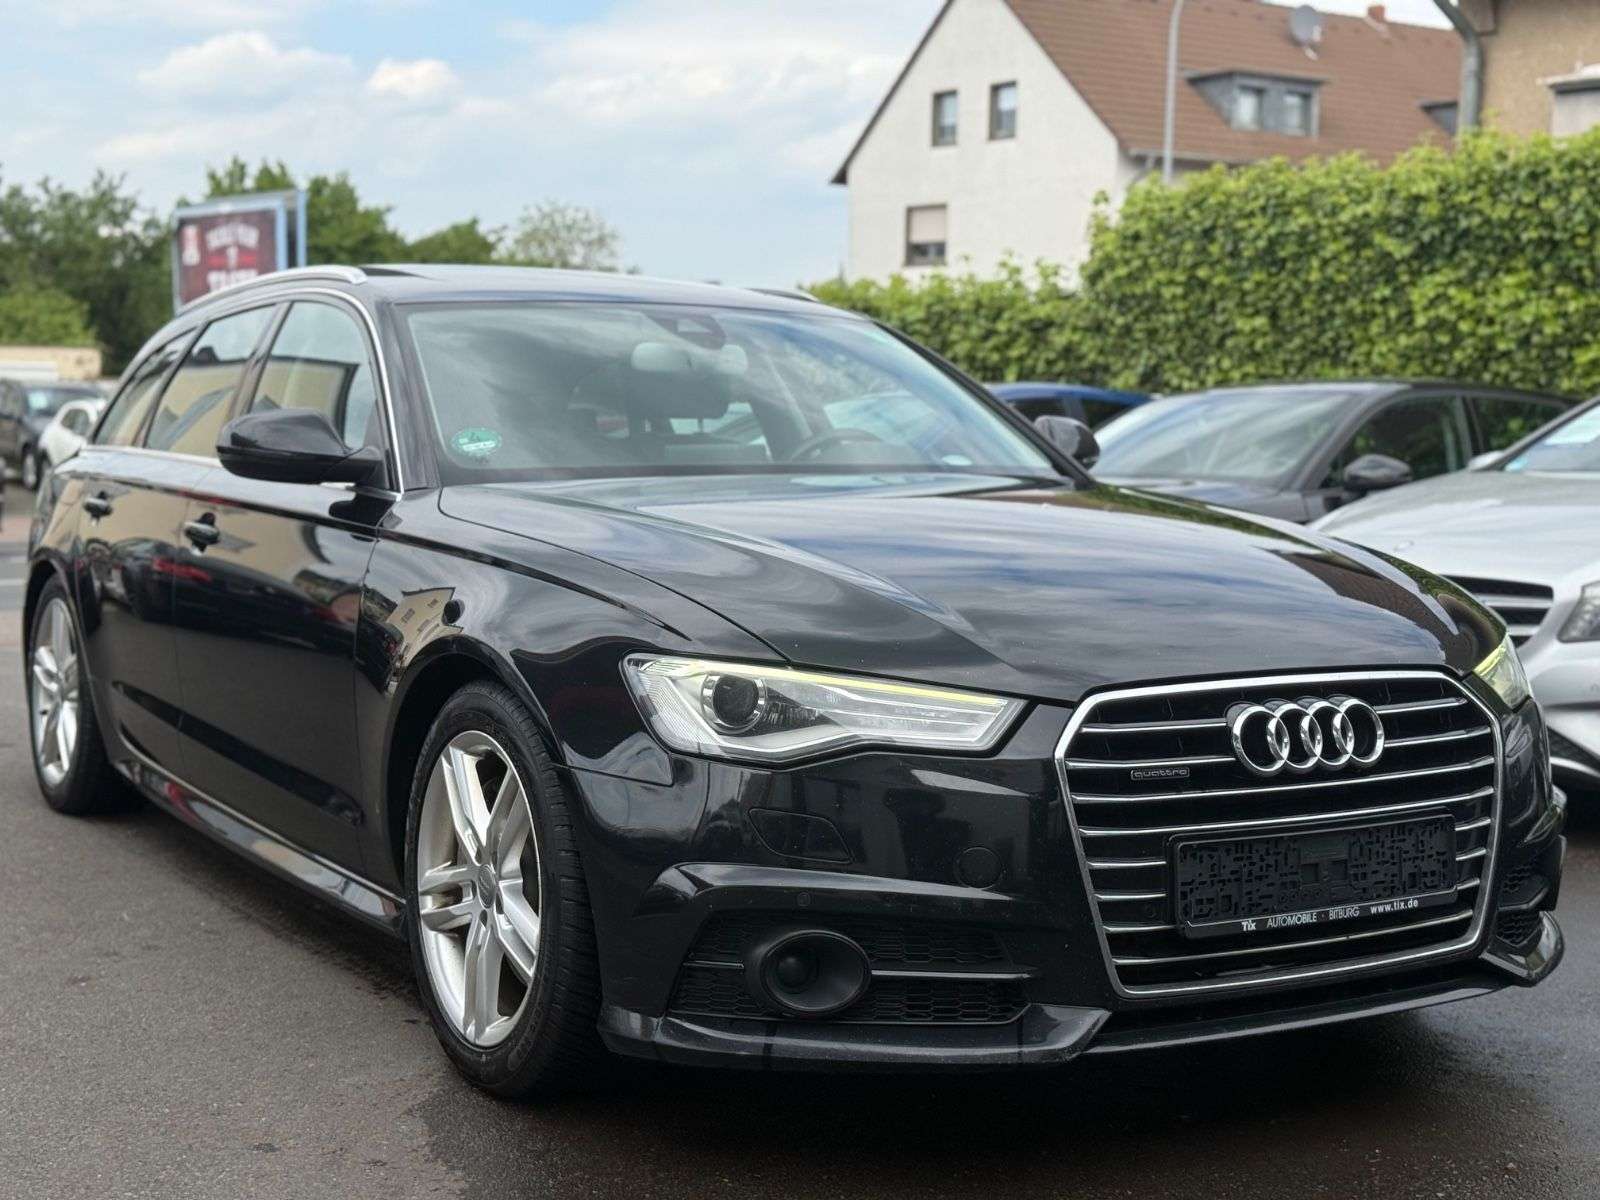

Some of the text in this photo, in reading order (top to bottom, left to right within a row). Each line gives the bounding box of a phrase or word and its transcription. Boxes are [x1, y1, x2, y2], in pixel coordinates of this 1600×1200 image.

[1133, 769, 1188, 780] quattro
[1266, 912, 1317, 929] AUTOMOBILE
[1329, 907, 1360, 920] BITBURG
